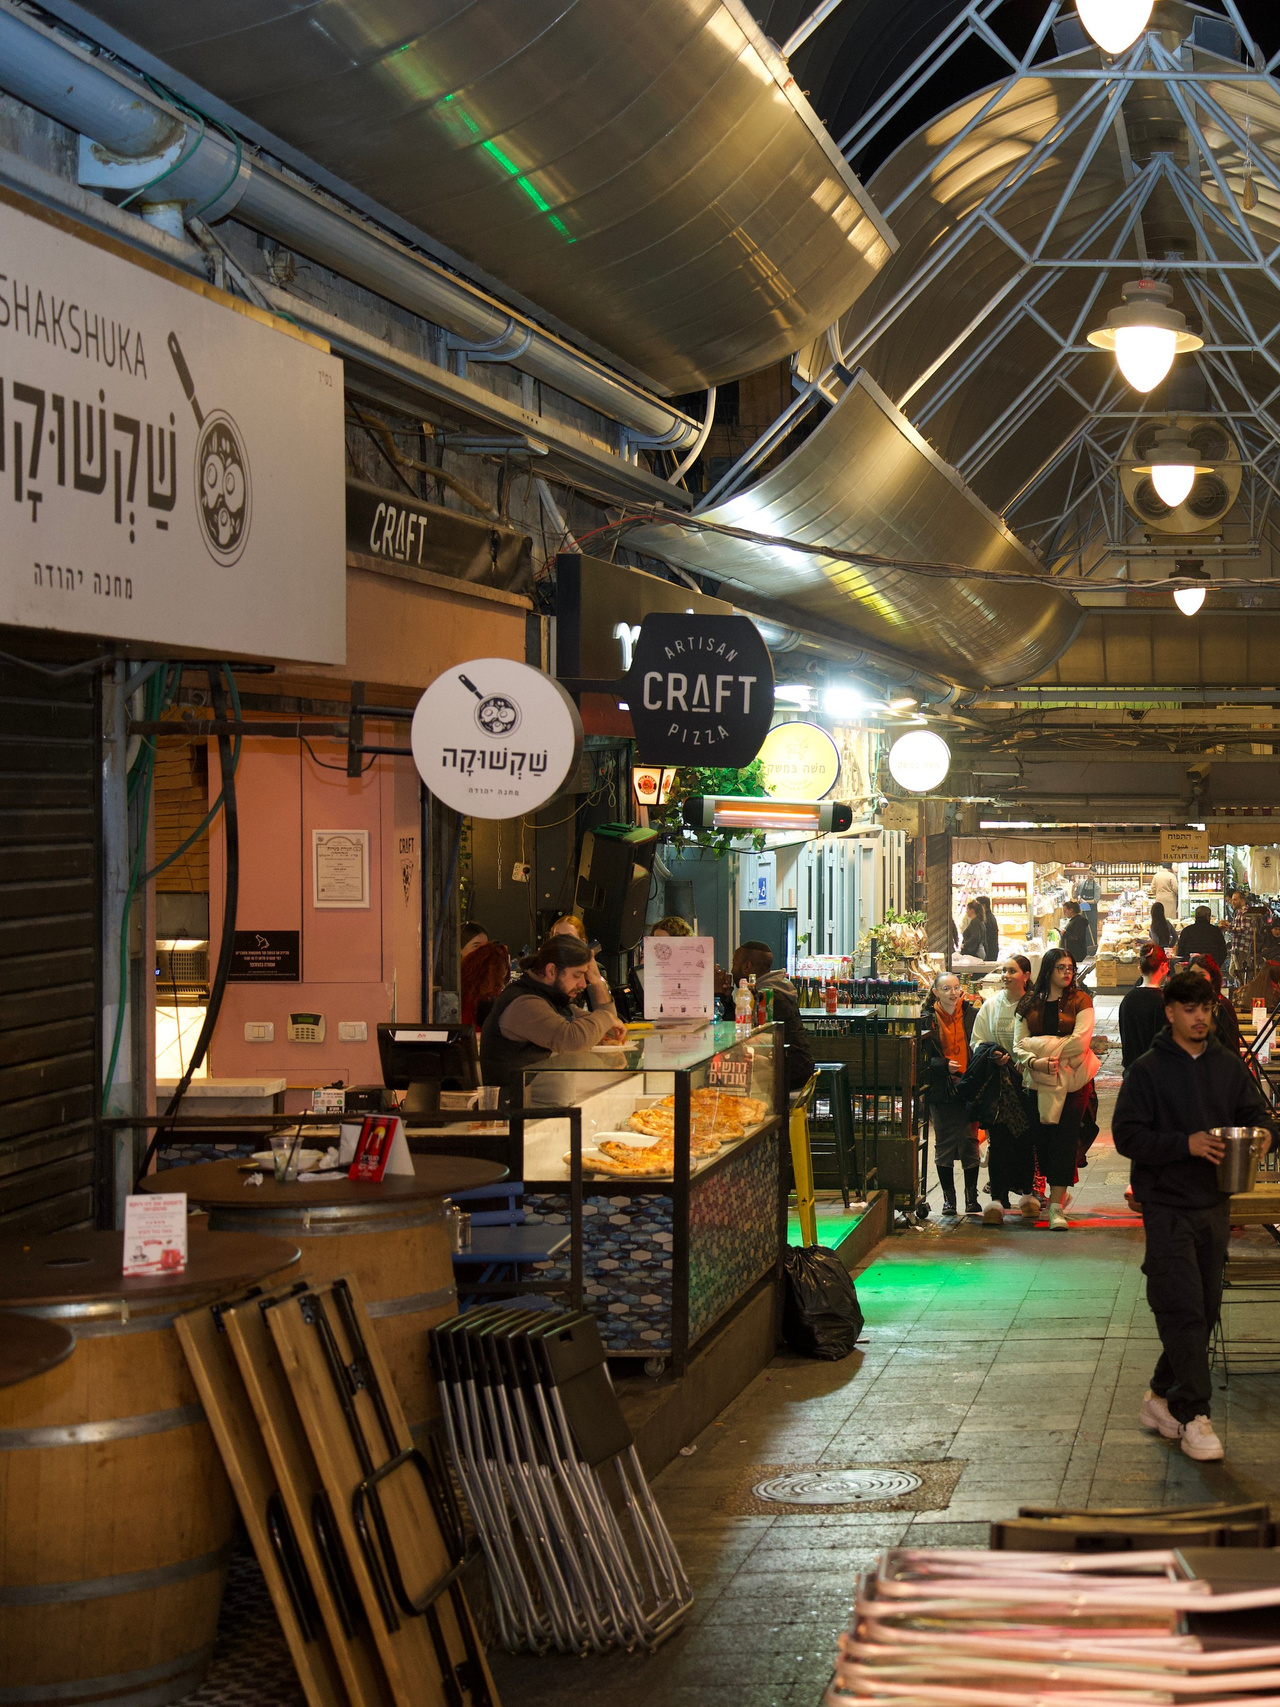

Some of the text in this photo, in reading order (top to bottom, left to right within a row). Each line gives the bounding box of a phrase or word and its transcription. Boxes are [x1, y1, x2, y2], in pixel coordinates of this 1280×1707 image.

[0, 274, 148, 381] SHAKSHUKA
[369, 502, 428, 565] CRAFT
[33, 562, 133, 600] מחנה יהודה
[664, 636, 738, 663] ARTISAN
[642, 671, 757, 715] CRAFT
[667, 723, 730, 746] PIZZA
[468, 786, 520, 797] מחנה יהודה
[708, 1072, 748, 1086] עובדים
[710, 1060, 748, 1073] דרושים
